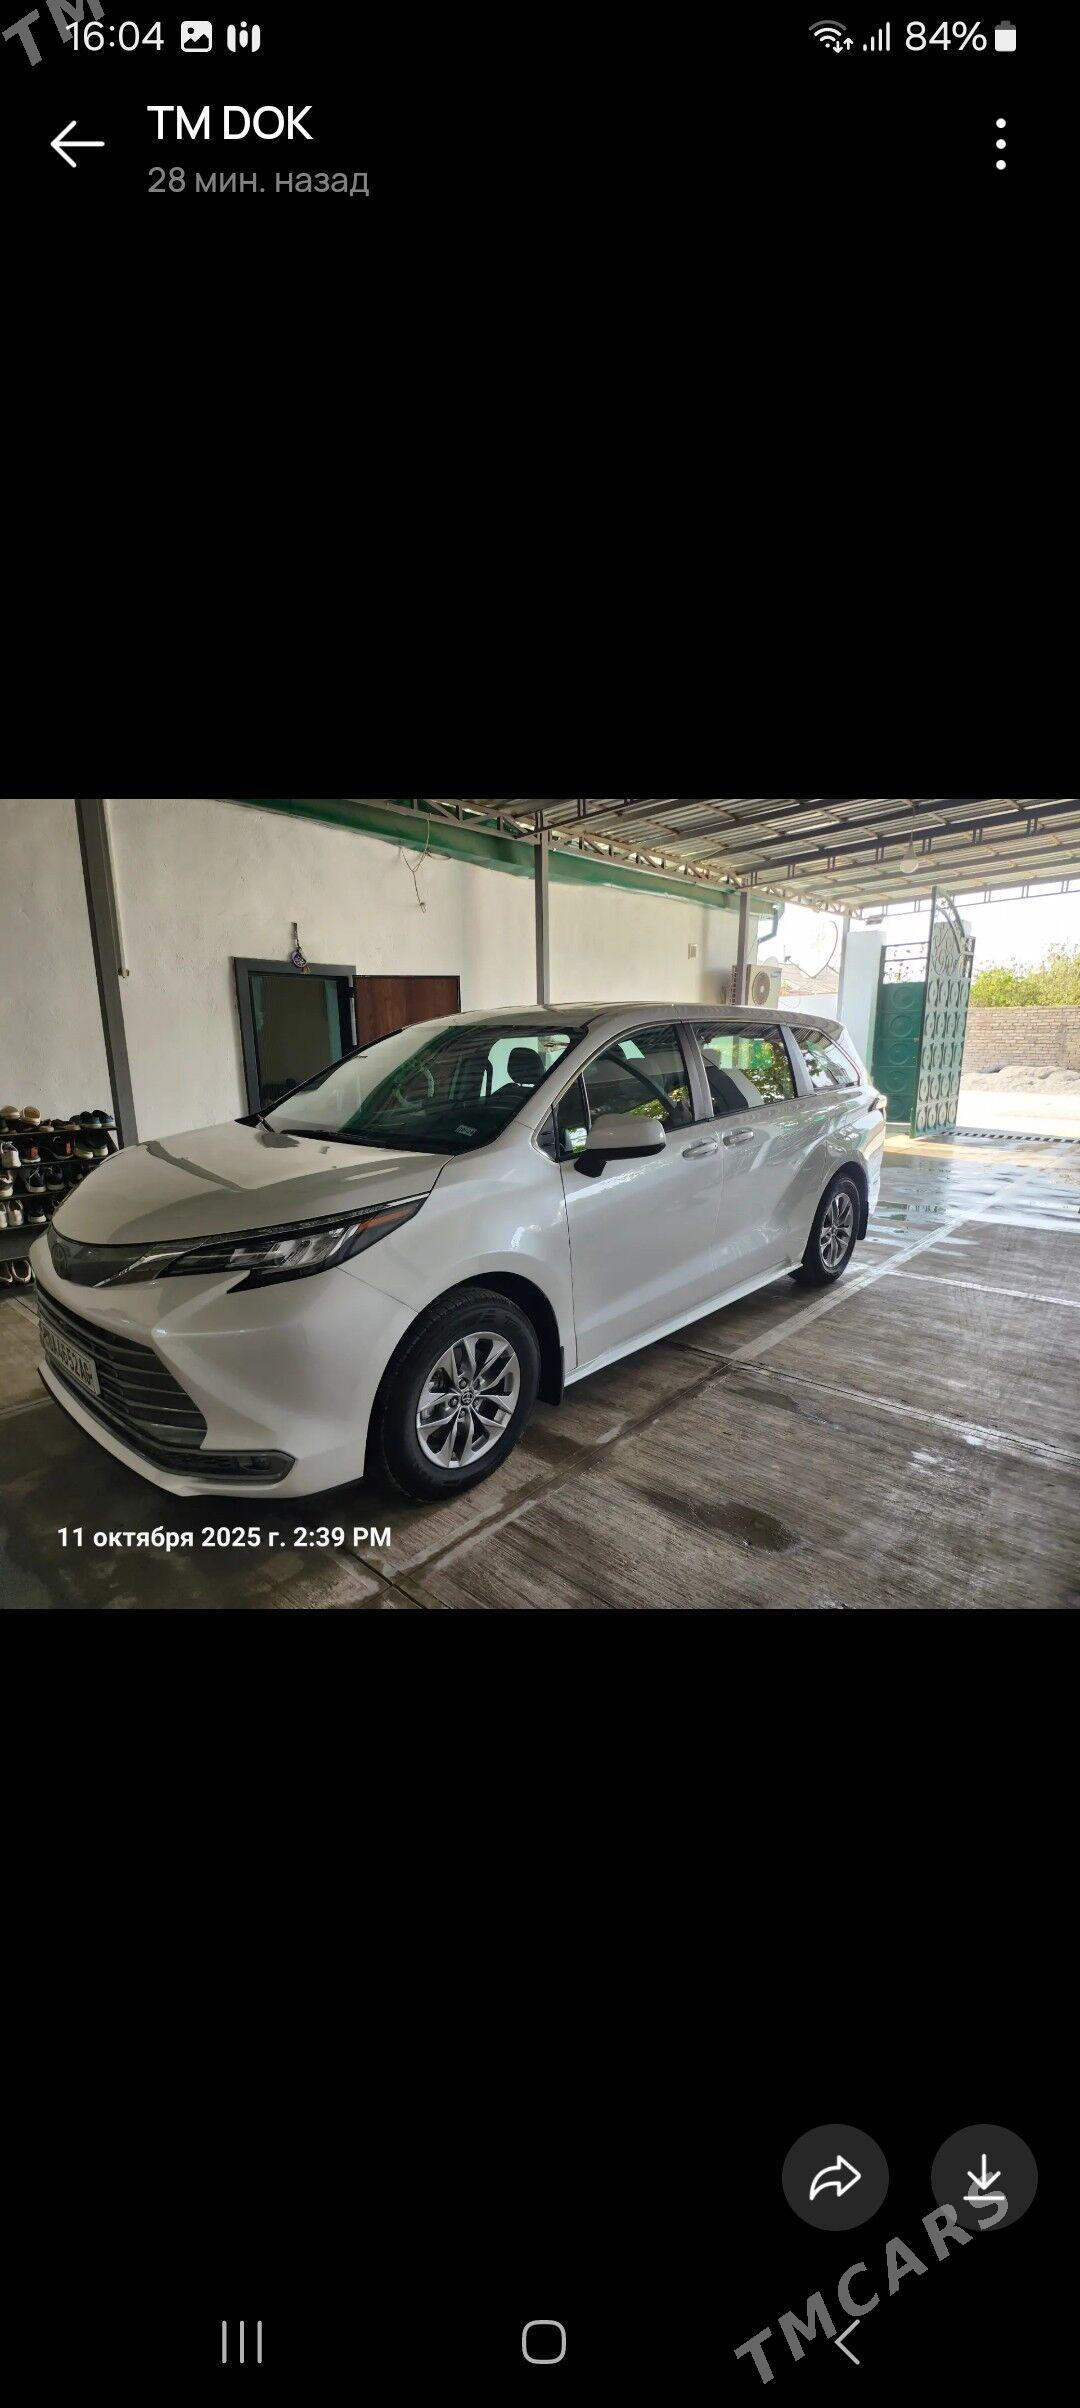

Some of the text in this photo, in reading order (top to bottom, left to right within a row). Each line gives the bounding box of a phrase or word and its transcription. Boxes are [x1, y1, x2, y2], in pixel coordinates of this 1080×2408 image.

[66, 21, 164, 51] 16:04
[905, 21, 987, 51] 84%
[147, 105, 314, 140] TM DOK
[147, 167, 370, 197] 28 мин. назад
